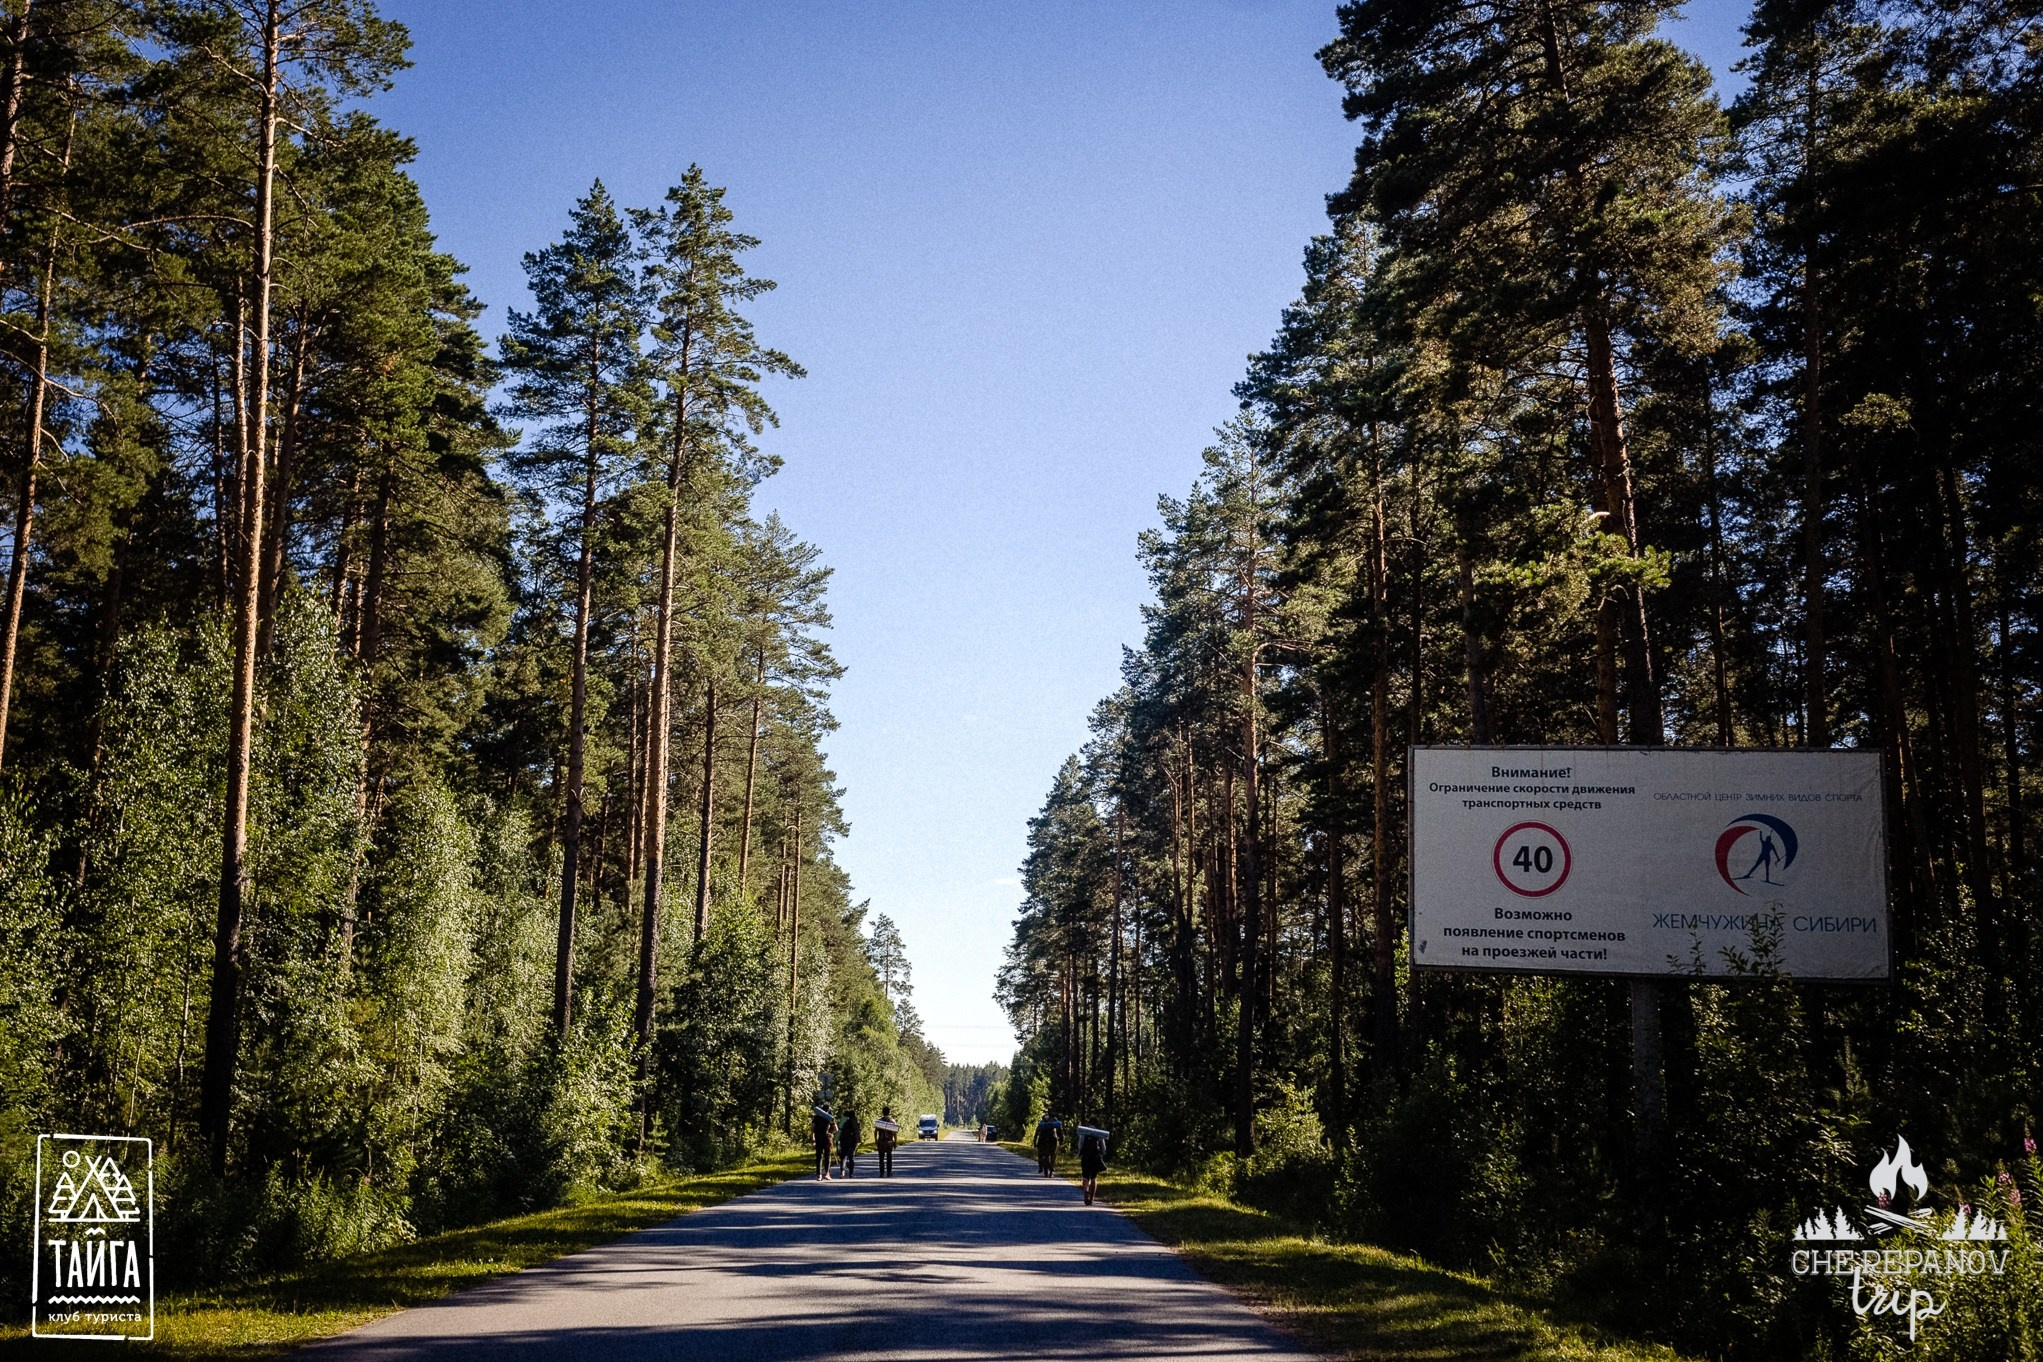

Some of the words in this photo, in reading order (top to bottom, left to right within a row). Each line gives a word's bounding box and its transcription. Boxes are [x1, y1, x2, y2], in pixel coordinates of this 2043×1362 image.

[1491, 766, 1572, 779] Внимание!
[1429, 782, 1510, 794] Ограничение
[1513, 784, 1569, 795] скорости
[1572, 784, 1635, 795] движения
[1653, 792, 1711, 801] ОБЛАСТНОЙ
[1715, 793, 1742, 801] ЦЕНТР
[1746, 793, 1784, 801] ЗИМНИХ
[1789, 794, 1821, 802] ВИДОВ
[1825, 794, 1863, 802] СПОРТА
[1462, 799, 1550, 810] транспортных
[1553, 800, 1601, 811] средств
[1512, 846, 1553, 873] 40
[1494, 907, 1572, 921] Возможно
[1793, 916, 1877, 933] СИБИРИ
[1443, 926, 1524, 939] появление
[1527, 930, 1625, 942] спортсменов
[1462, 946, 1479, 956] на
[1483, 946, 1557, 959] проезжей
[1561, 948, 1608, 960] части!
